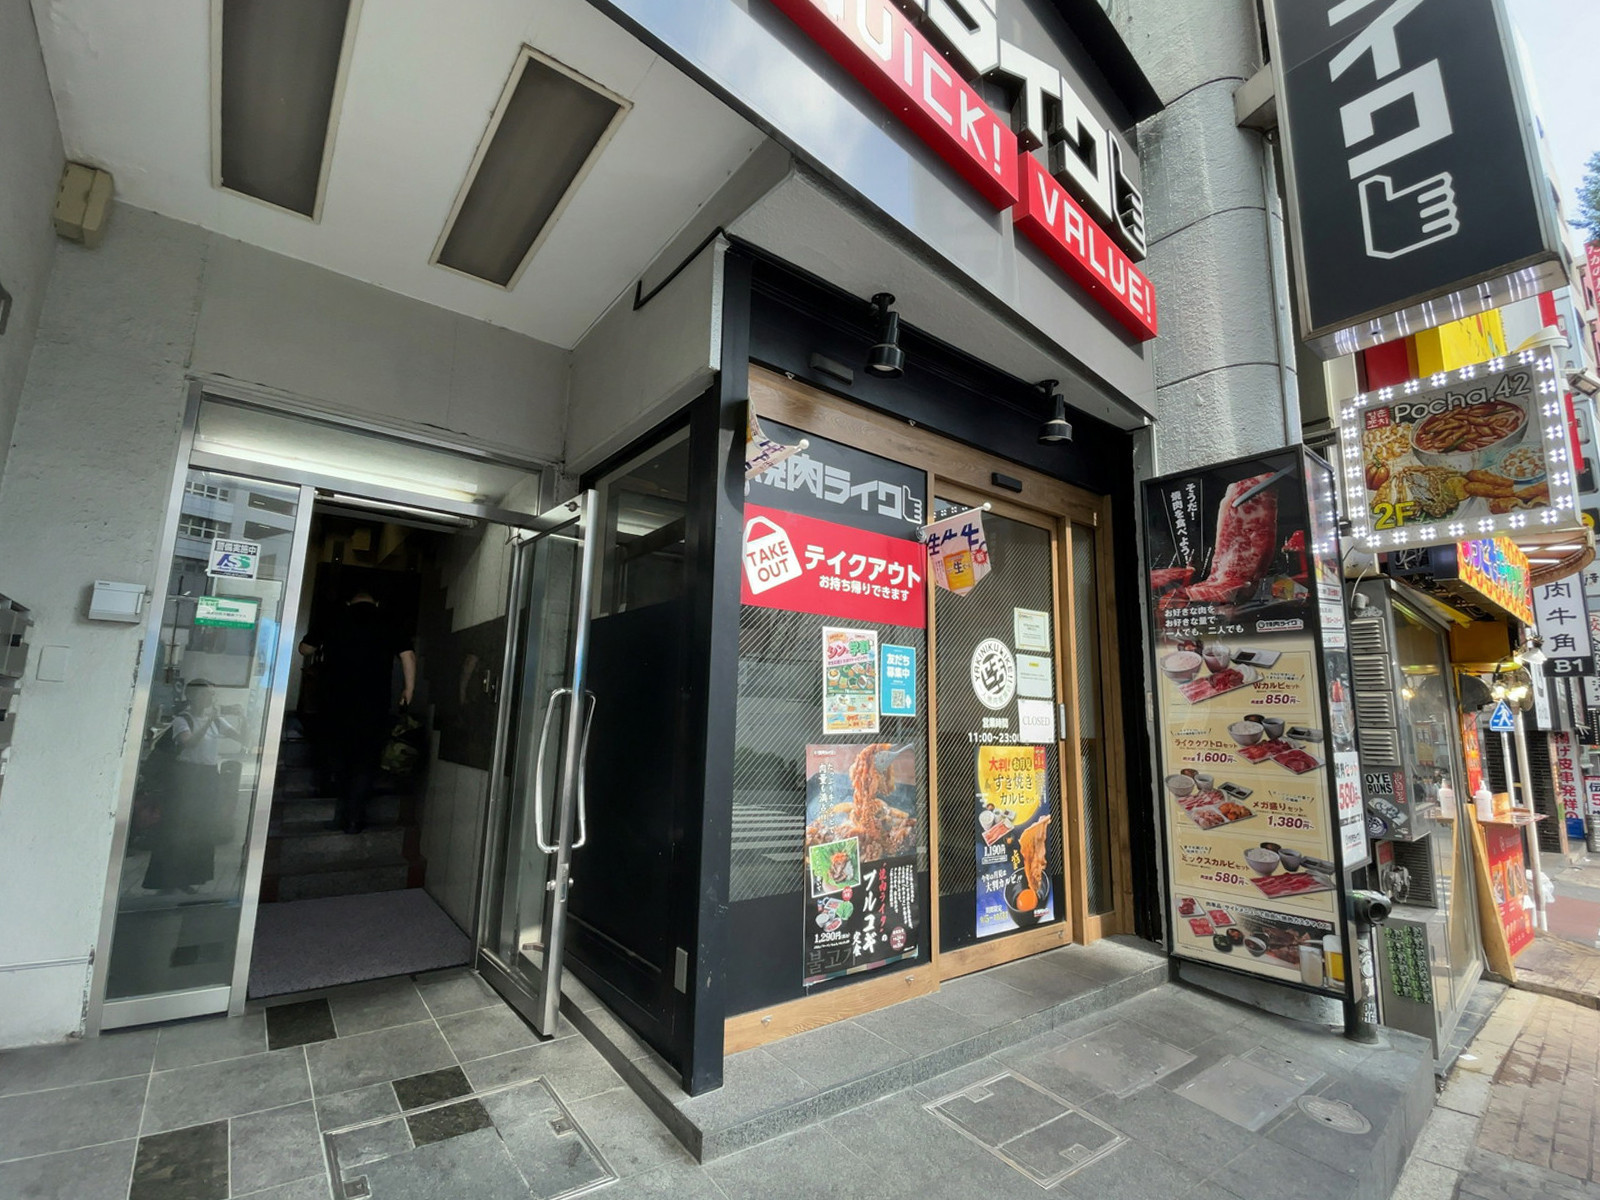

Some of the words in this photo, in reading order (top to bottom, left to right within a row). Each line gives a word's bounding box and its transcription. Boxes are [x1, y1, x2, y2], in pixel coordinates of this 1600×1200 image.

[822, 0, 1002, 175] UICK!
[1037, 172, 1152, 324] VALUE!
[1373, 501, 1415, 530] 2F
[747, 539, 789, 568] TAKE
[757, 559, 789, 583] OUT
[805, 544, 921, 588] テイクアウト
[819, 575, 909, 601] お持ち帰りできます
[1165, 605, 1215, 617] お好きな肉を
[1554, 658, 1584, 673] B1
[1022, 715, 1051, 726] CLOSED
[968, 732, 1019, 743] 11:00~23:0
[1366, 773, 1390, 784] OYE
[1368, 784, 1393, 794] RUNS
